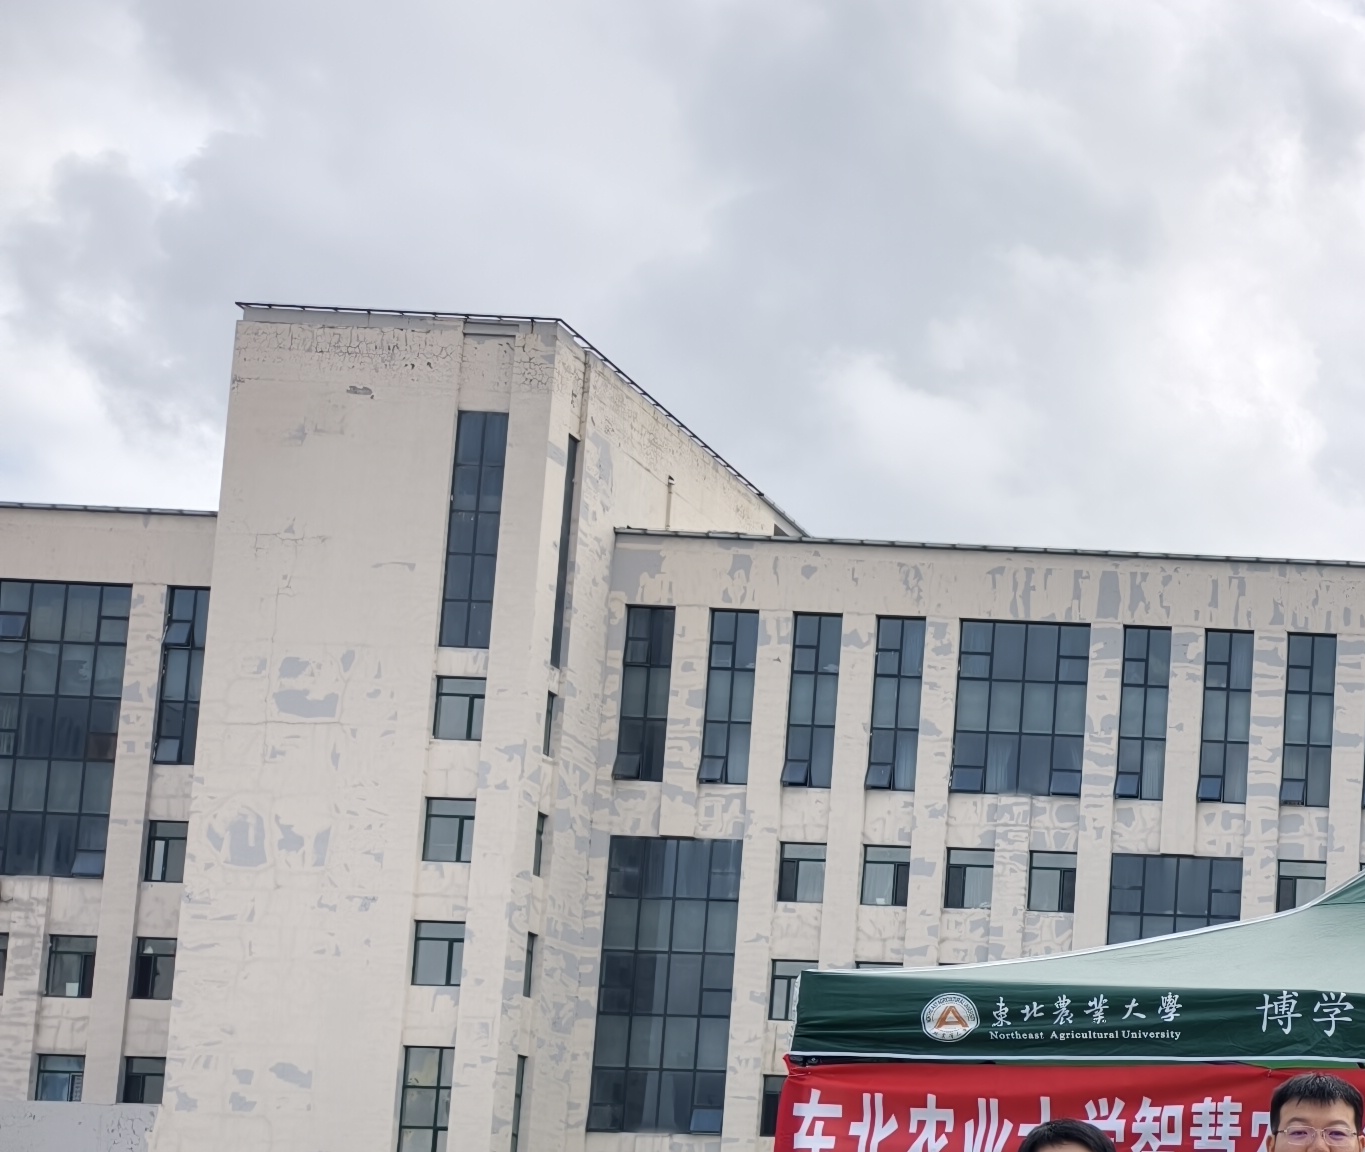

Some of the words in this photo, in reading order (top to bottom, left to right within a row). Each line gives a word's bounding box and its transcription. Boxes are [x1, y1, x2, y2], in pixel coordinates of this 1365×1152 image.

[989, 1030, 1044, 1040] Northeast
[1050, 1030, 1119, 1041] Agricultural
[1122, 1030, 1182, 1041] University
